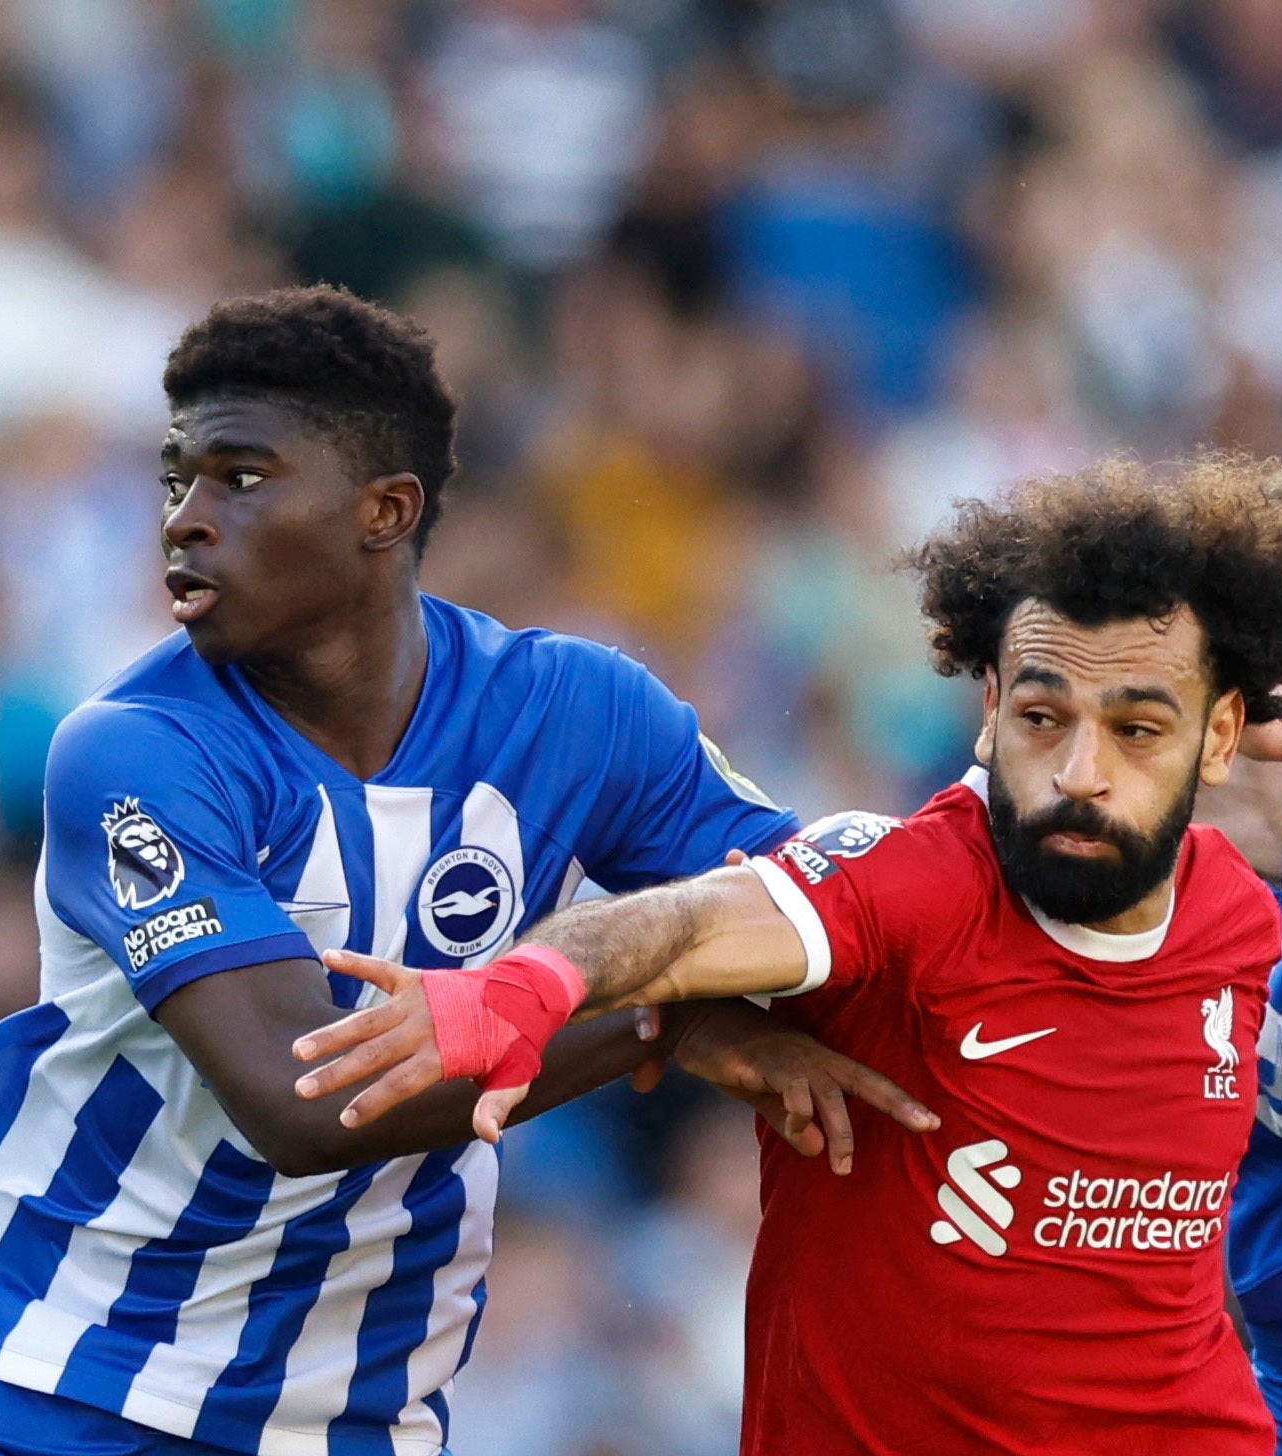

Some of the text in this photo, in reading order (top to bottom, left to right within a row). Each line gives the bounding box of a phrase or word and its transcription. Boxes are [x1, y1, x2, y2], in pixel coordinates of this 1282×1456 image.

[427, 852, 503, 886] BRIGHTON & HOVE
[123, 903, 207, 951] No room
[129, 918, 222, 972] for racism
[446, 940, 482, 954] ALBION
[1043, 1168, 1231, 1212] standard
